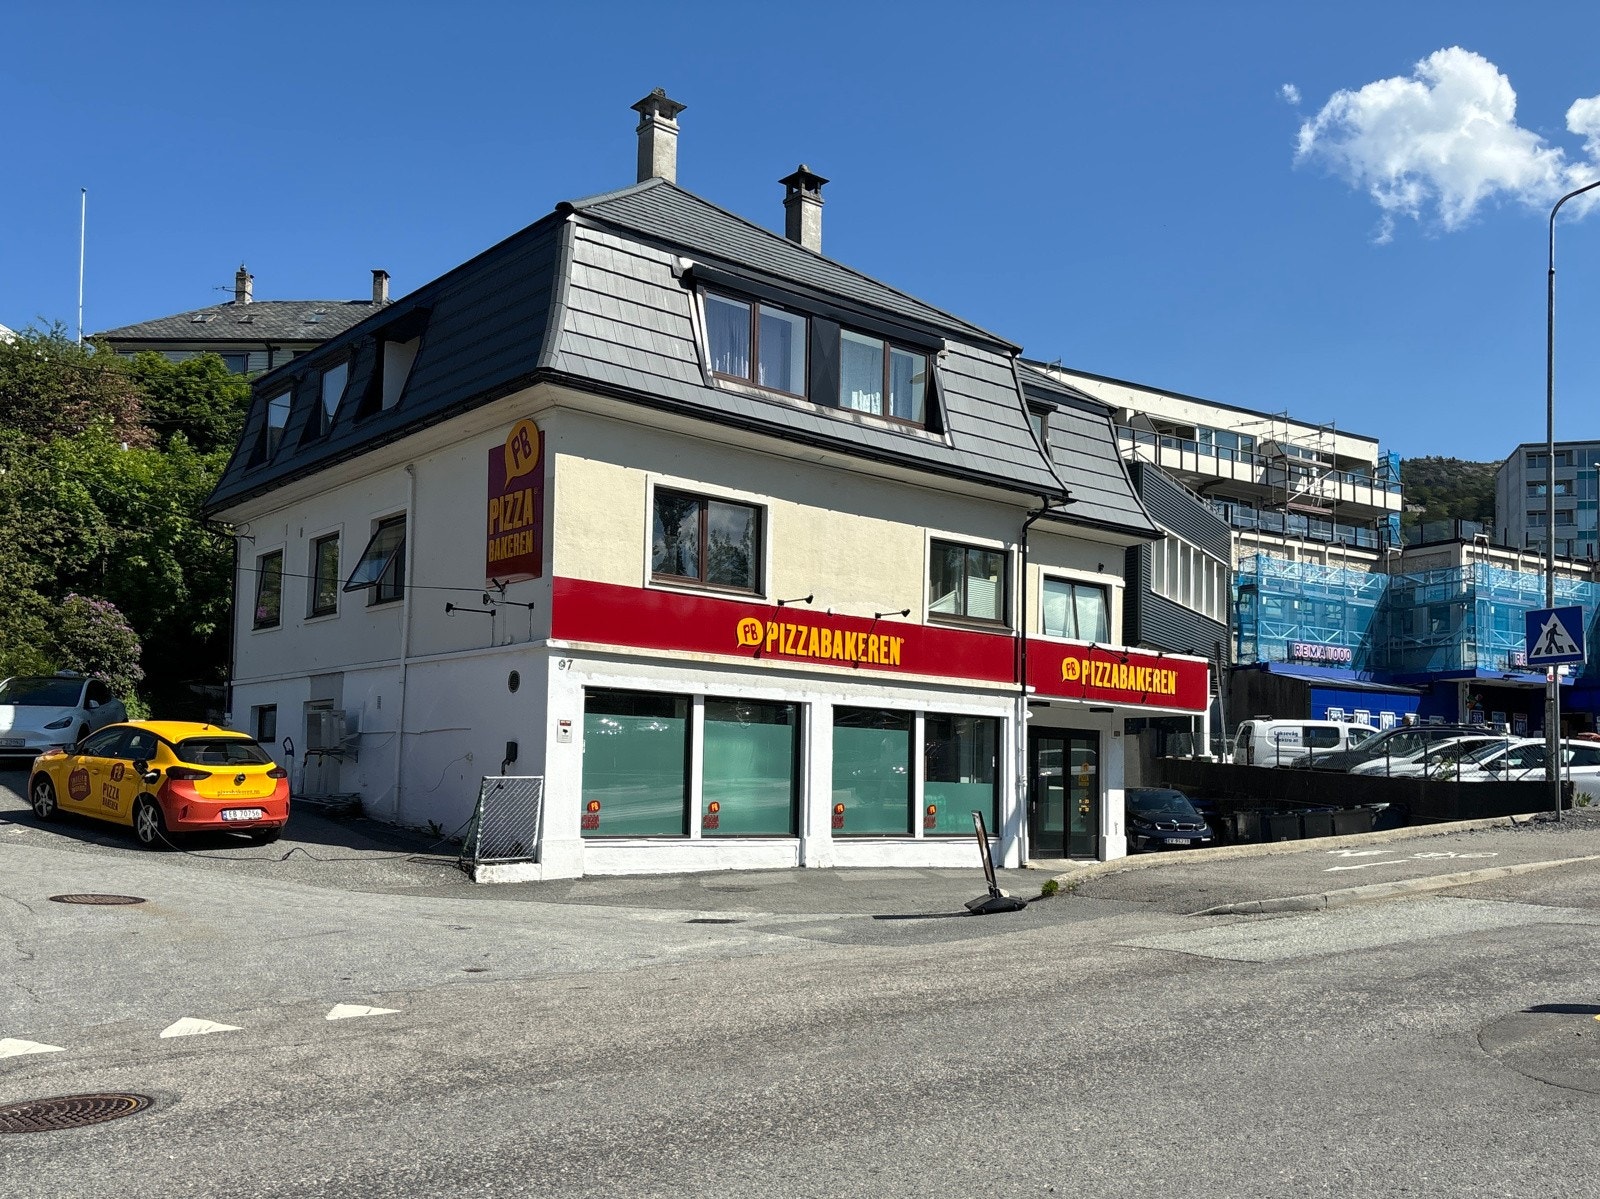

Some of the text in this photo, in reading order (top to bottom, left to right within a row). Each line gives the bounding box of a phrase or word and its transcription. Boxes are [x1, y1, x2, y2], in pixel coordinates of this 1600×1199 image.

[511, 426, 532, 470] PB
[489, 487, 534, 535] PIZZA
[488, 529, 534, 563] BAKEREN
[743, 621, 901, 666] PB PIZZABAKEREN
[1294, 643, 1352, 661] REMA 1000
[558, 659, 574, 670] 97
[1081, 659, 1177, 695] PIZZABAKEREN
[102, 782, 120, 801] PIZZA
